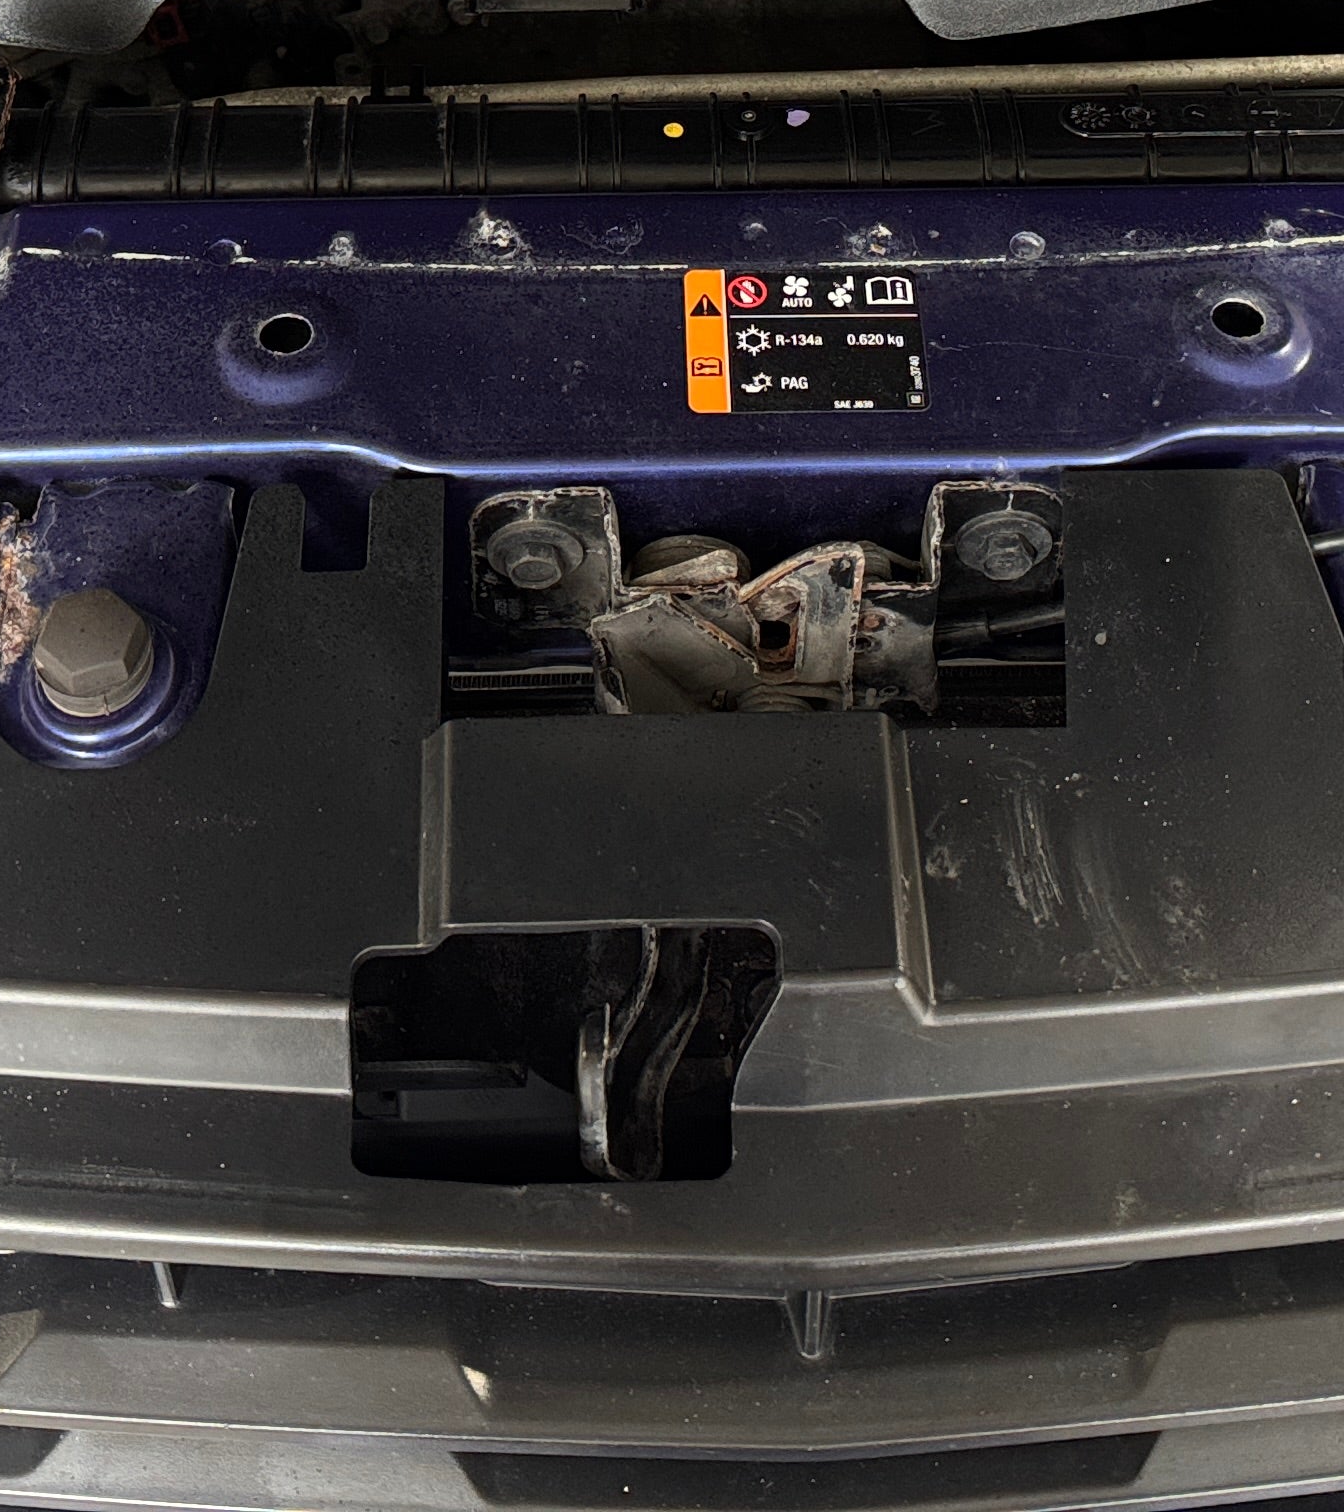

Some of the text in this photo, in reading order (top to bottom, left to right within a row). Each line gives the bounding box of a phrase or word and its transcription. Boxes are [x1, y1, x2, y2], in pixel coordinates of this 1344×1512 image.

[781, 297, 813, 308] AUTO
[775, 334, 904, 348] R-134a 0.620 kg
[780, 377, 809, 390] PAG
[833, 400, 852, 409] SAE
